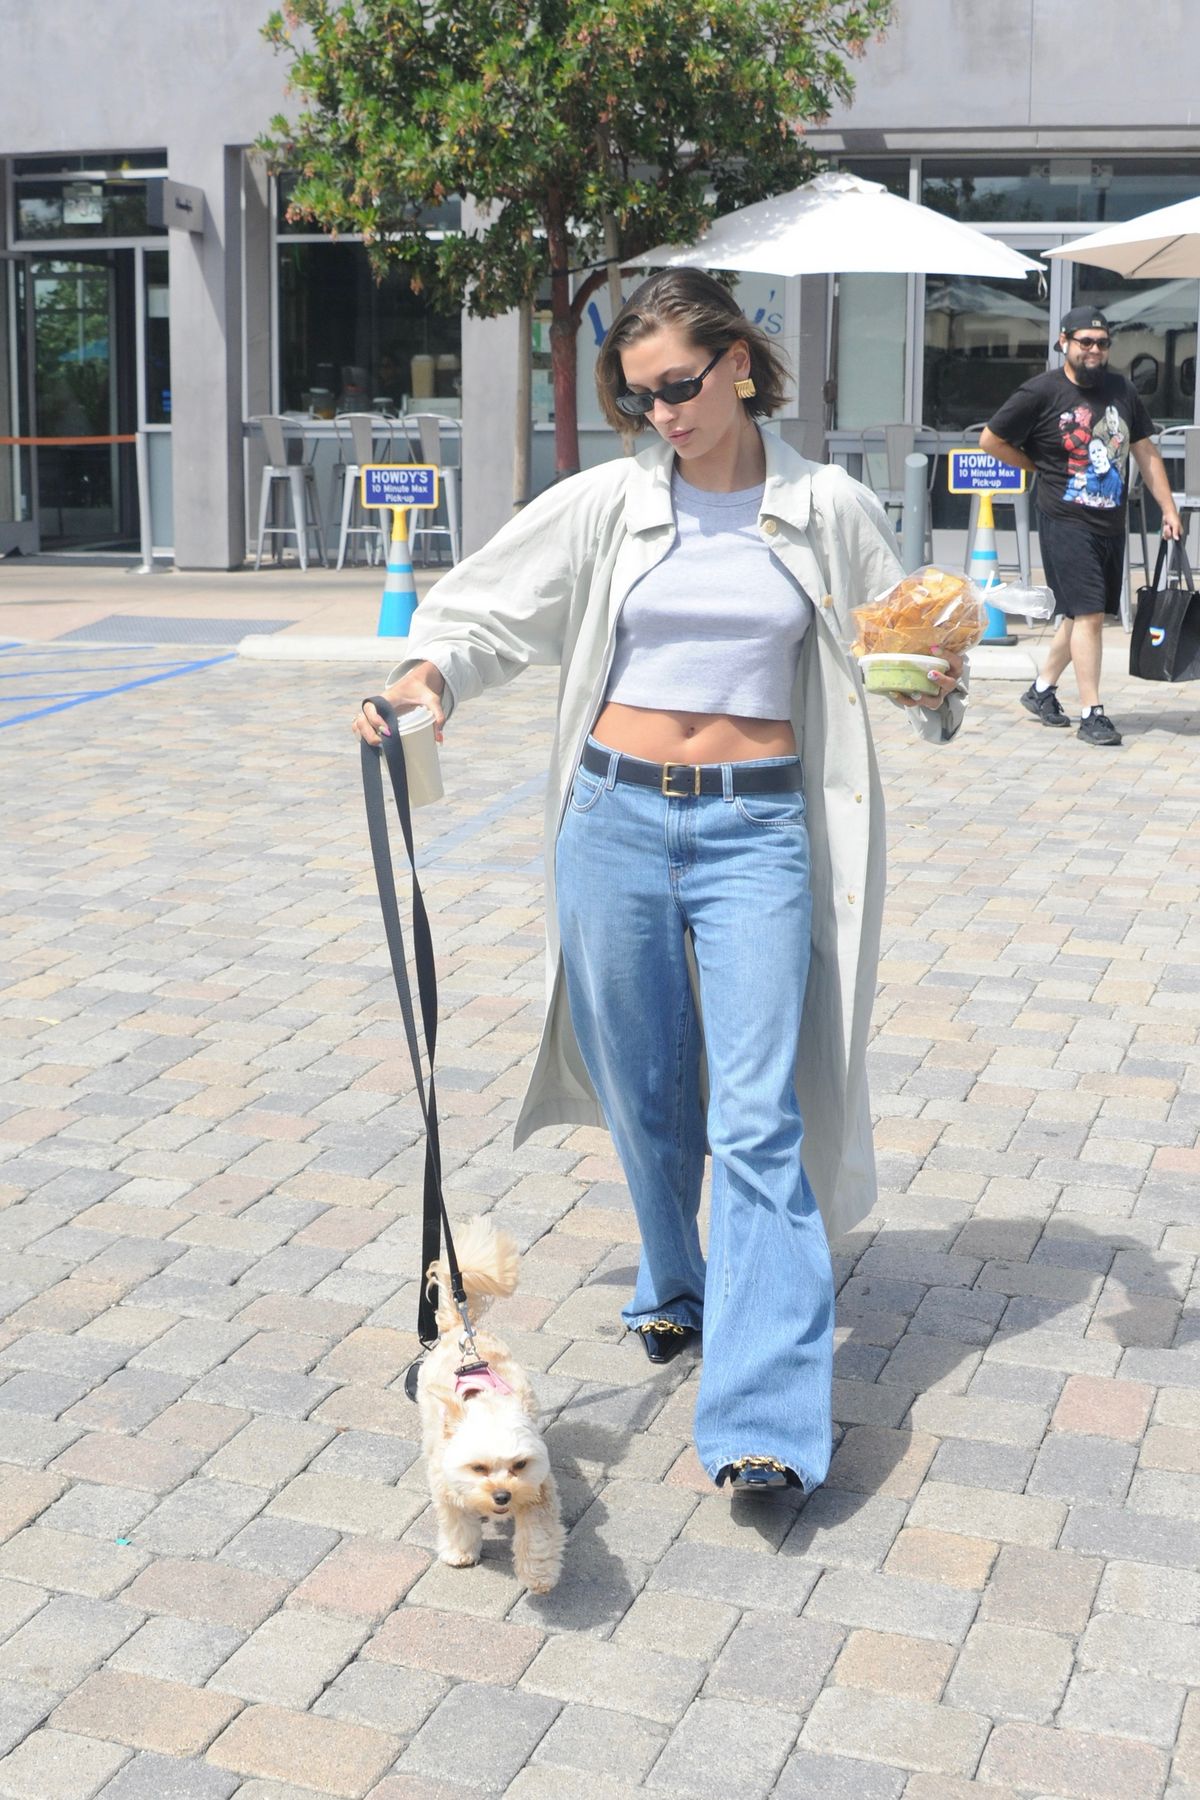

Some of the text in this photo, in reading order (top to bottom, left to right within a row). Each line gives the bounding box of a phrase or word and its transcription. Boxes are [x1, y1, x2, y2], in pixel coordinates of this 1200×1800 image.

[372, 471, 428, 484] HOWDY'S
[959, 469, 1015, 477] 10 Minute Max
[972, 478, 1001, 488] Pick-up
[385, 494, 415, 503] Pick-up
